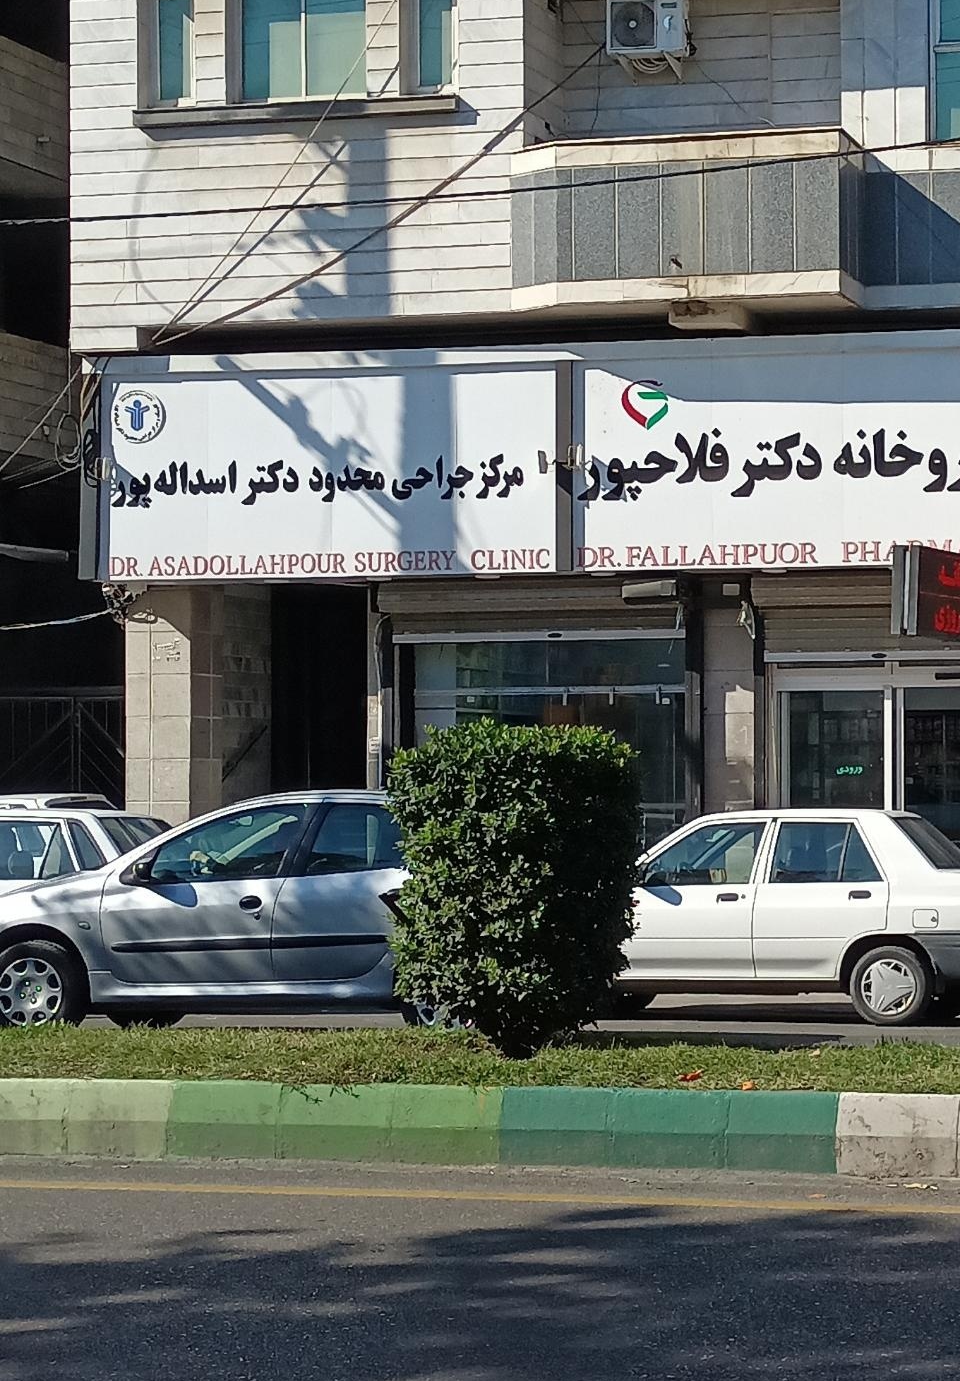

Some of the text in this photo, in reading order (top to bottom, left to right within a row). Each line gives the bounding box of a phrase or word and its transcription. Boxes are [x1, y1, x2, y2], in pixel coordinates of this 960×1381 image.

[241, 460, 299, 505] دکتر
[308, 462, 386, 503] محدود
[391, 456, 475, 500] جراحی
[475, 454, 525, 499] مرکز
[577, 428, 731, 501] فلاحپور
[731, 433, 823, 498] دکتر
[147, 552, 347, 575] ASADOLLAHPOUR
[354, 549, 456, 573] SURGERY
[470, 548, 551, 569] CLINIC
[836, 765, 863, 775] ورودی
